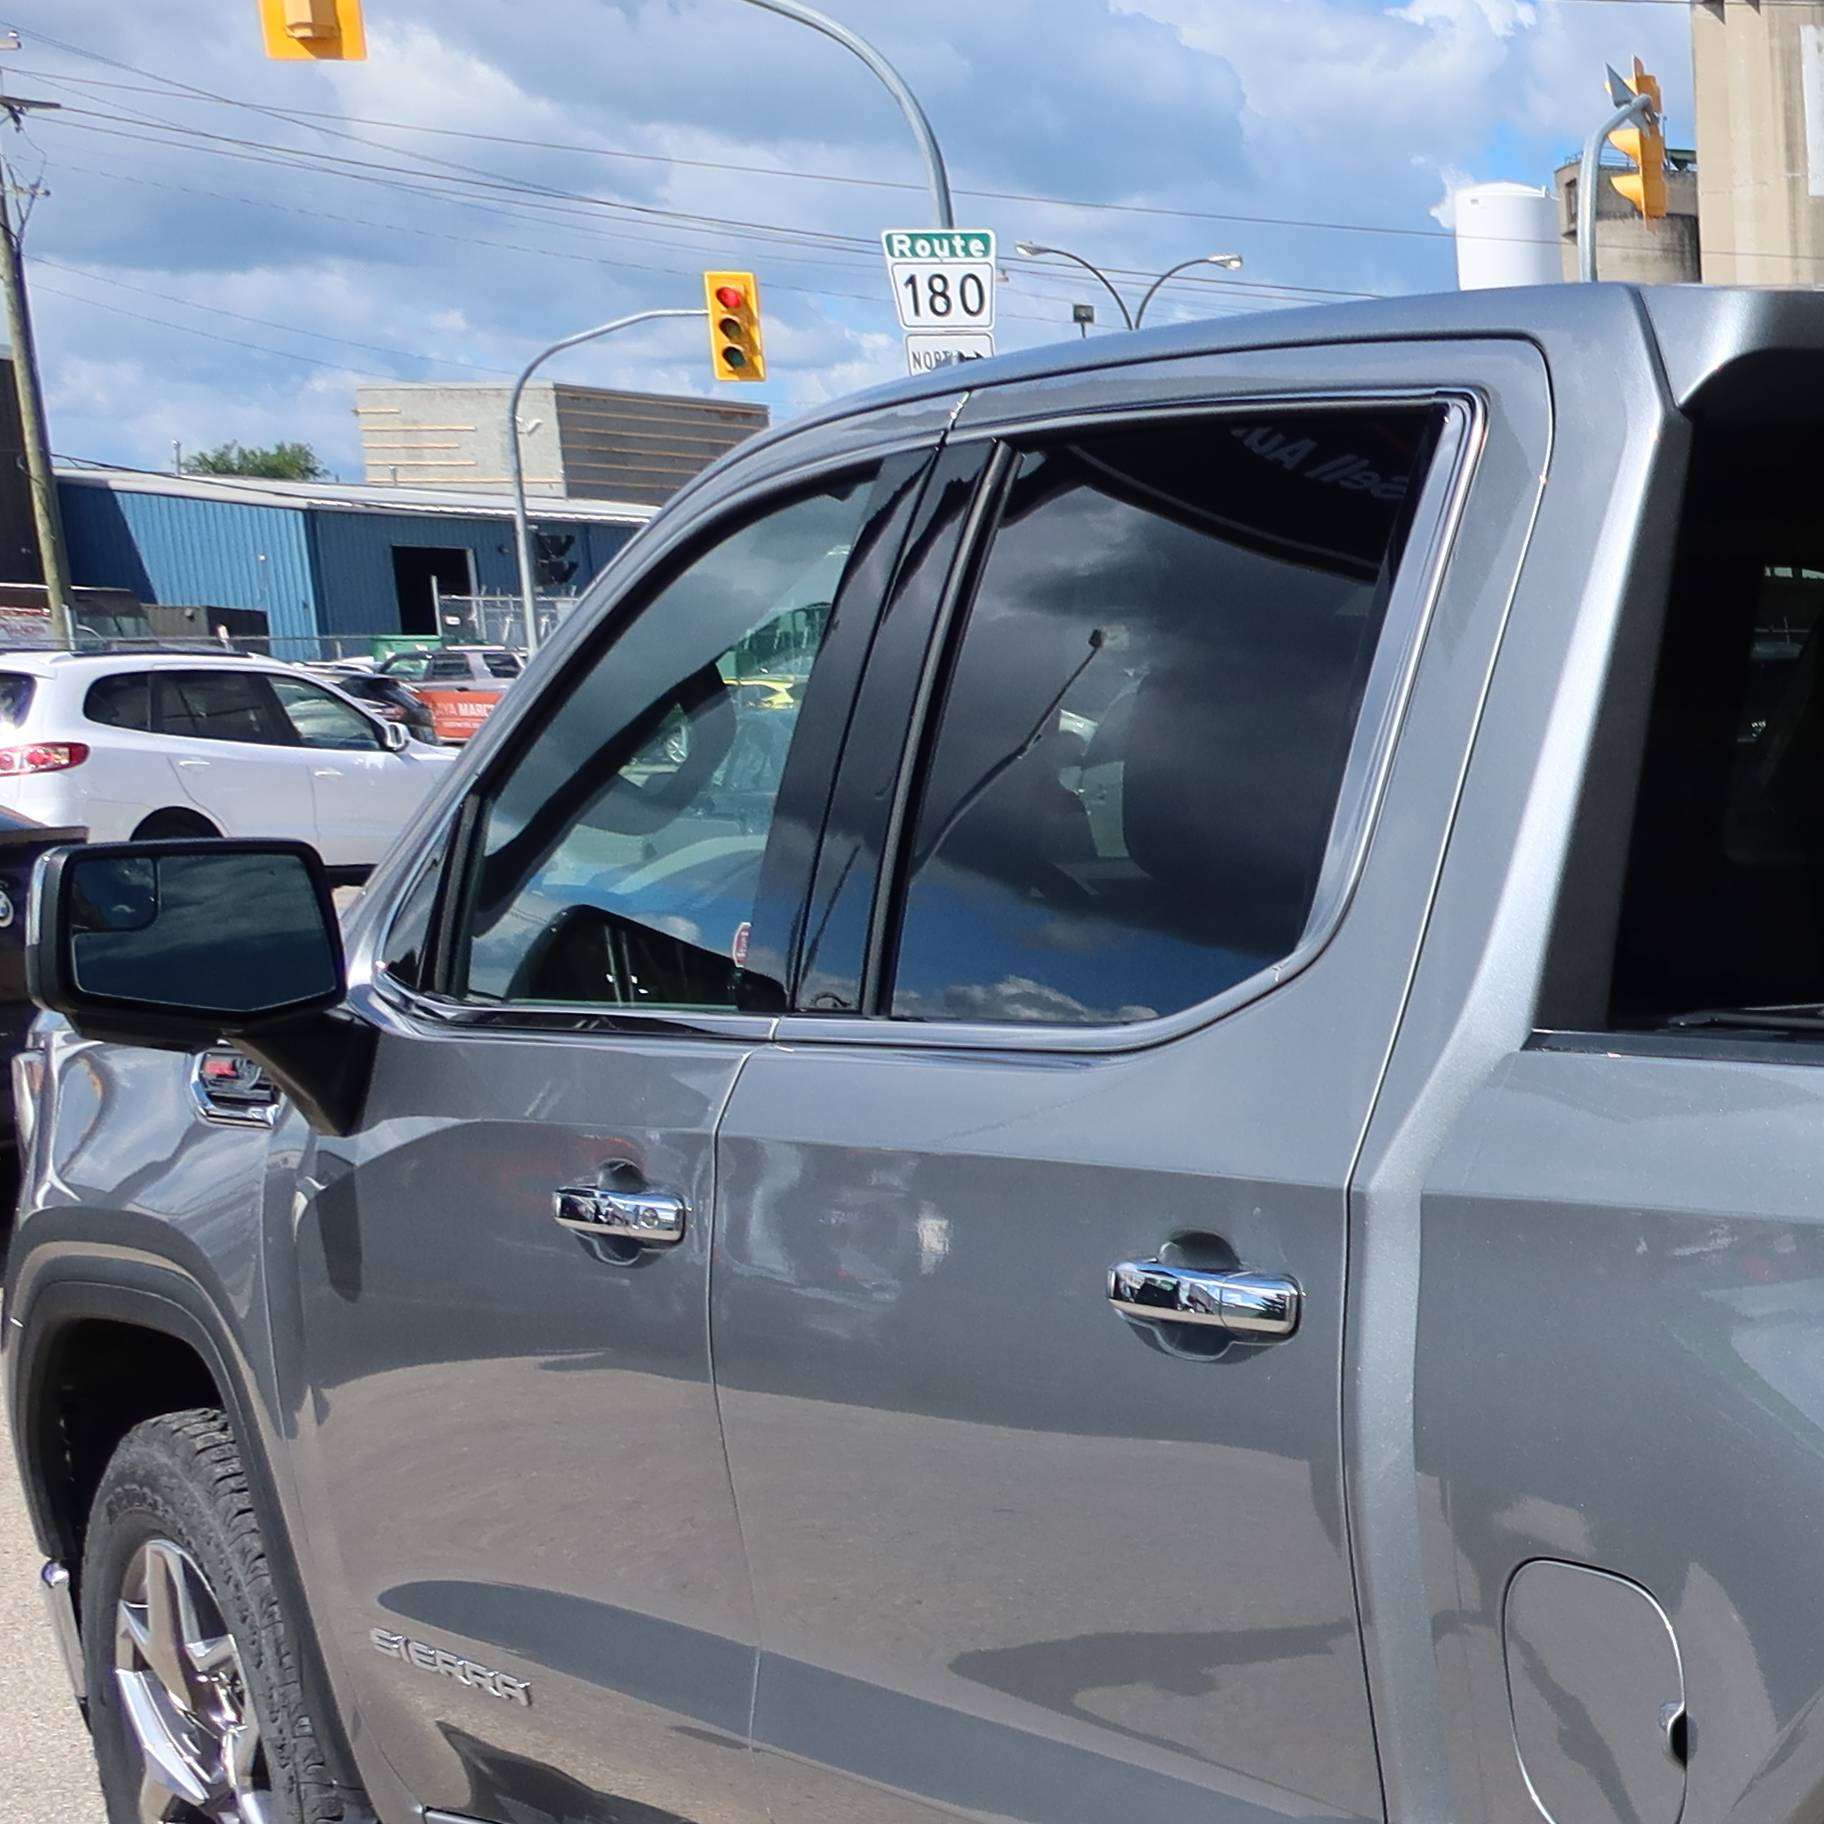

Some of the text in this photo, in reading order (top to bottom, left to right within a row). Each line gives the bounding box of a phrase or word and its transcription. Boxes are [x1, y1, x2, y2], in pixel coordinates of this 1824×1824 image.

[892, 234, 986, 257] Route
[904, 273, 985, 317] 180
[370, 1627, 533, 1706] SIERRA
